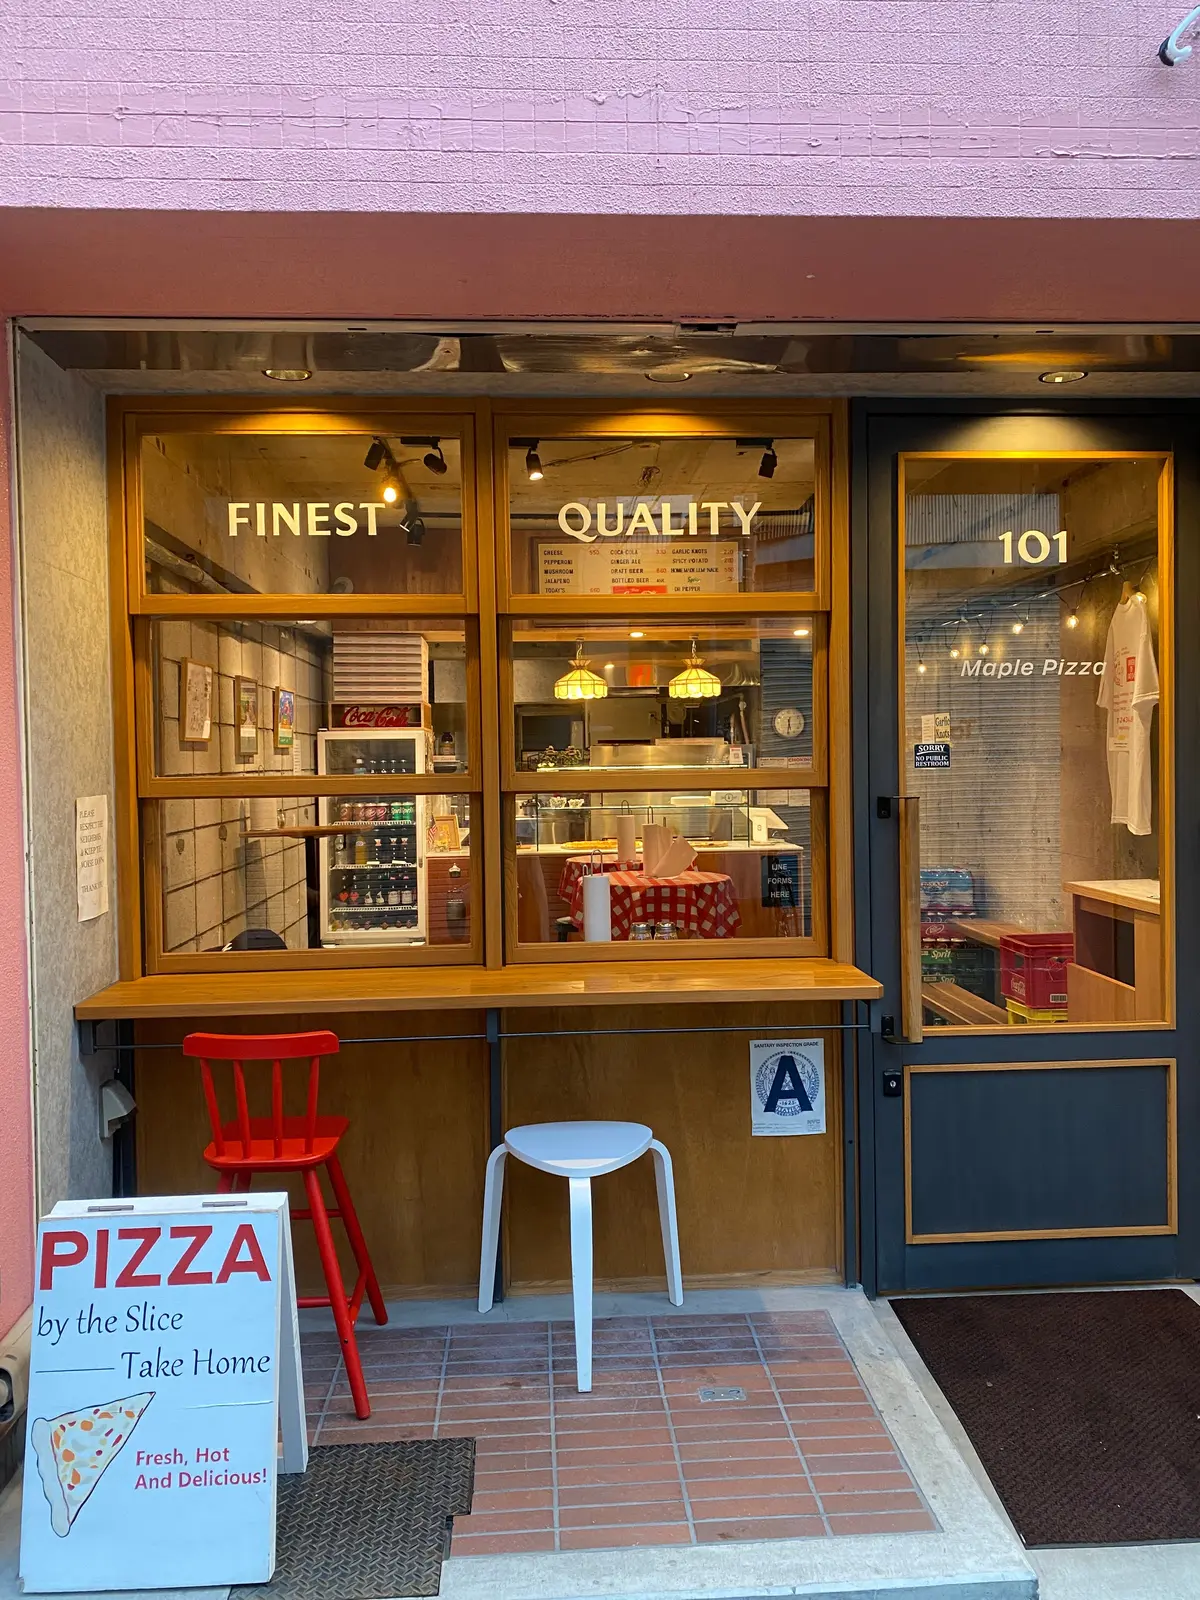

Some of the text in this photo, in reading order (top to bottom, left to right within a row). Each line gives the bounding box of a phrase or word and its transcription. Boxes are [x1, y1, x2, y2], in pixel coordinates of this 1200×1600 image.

[228, 502, 385, 537] FINEST
[558, 501, 762, 543] QUALITY
[998, 530, 1068, 564] 101
[960, 658, 1034, 679] Maple
[1042, 659, 1107, 677] Pizza
[918, 744, 946, 752] SORRY
[80, 809, 95, 818] PLEASE
[767, 877, 792, 885] FORMS
[771, 863, 788, 871] LINE
[764, 1055, 813, 1112] A
[39, 1223, 272, 1291] PIZZA
[37, 1300, 184, 1345] by the Slice
[121, 1346, 271, 1380] Take Home
[135, 1447, 230, 1468] Fresh, Hot
[134, 1468, 267, 1490] And Delicious!
